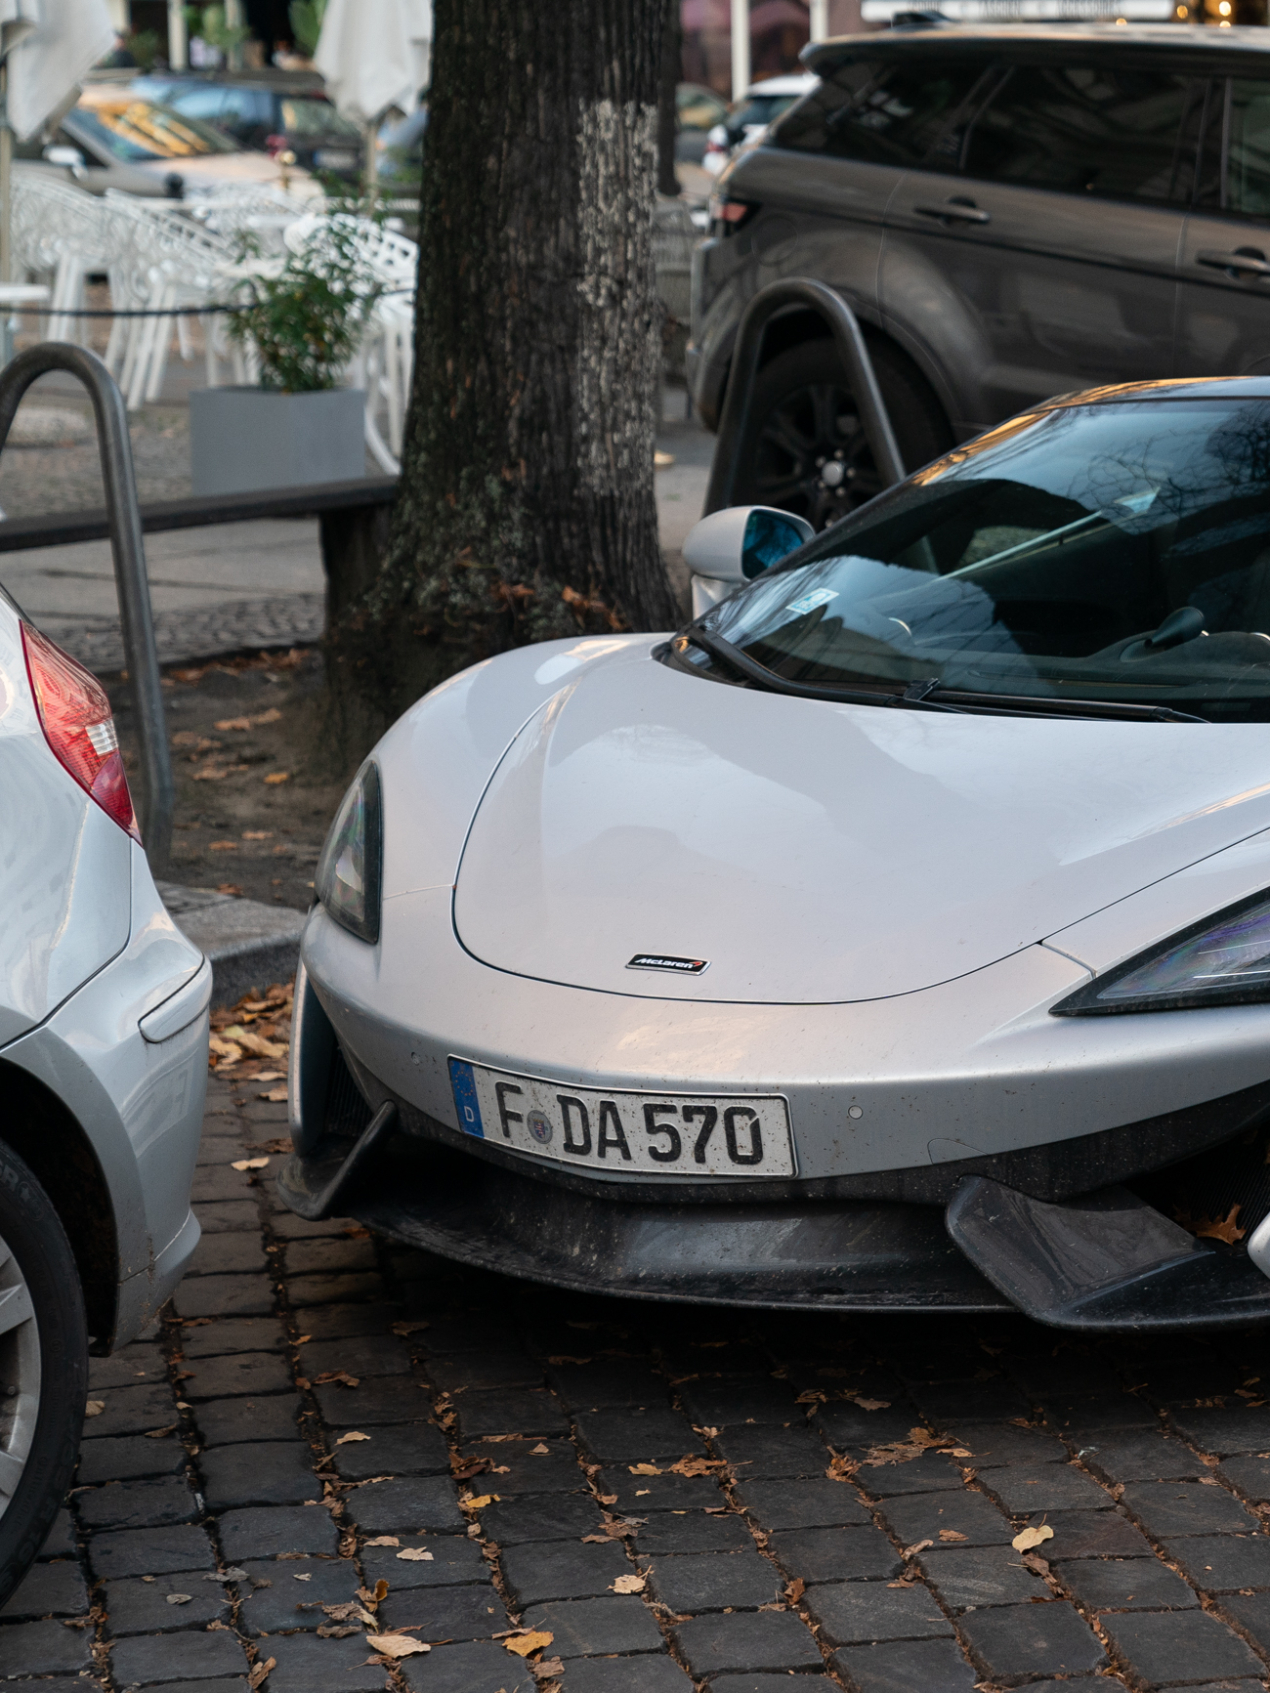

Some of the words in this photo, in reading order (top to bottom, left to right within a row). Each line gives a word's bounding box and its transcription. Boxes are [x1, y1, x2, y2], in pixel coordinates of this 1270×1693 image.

[634, 957, 694, 970] McLaren
[464, 1106, 475, 1122] D
[494, 1080, 525, 1139] F
[556, 1094, 632, 1161] DA
[643, 1103, 764, 1165] 570
